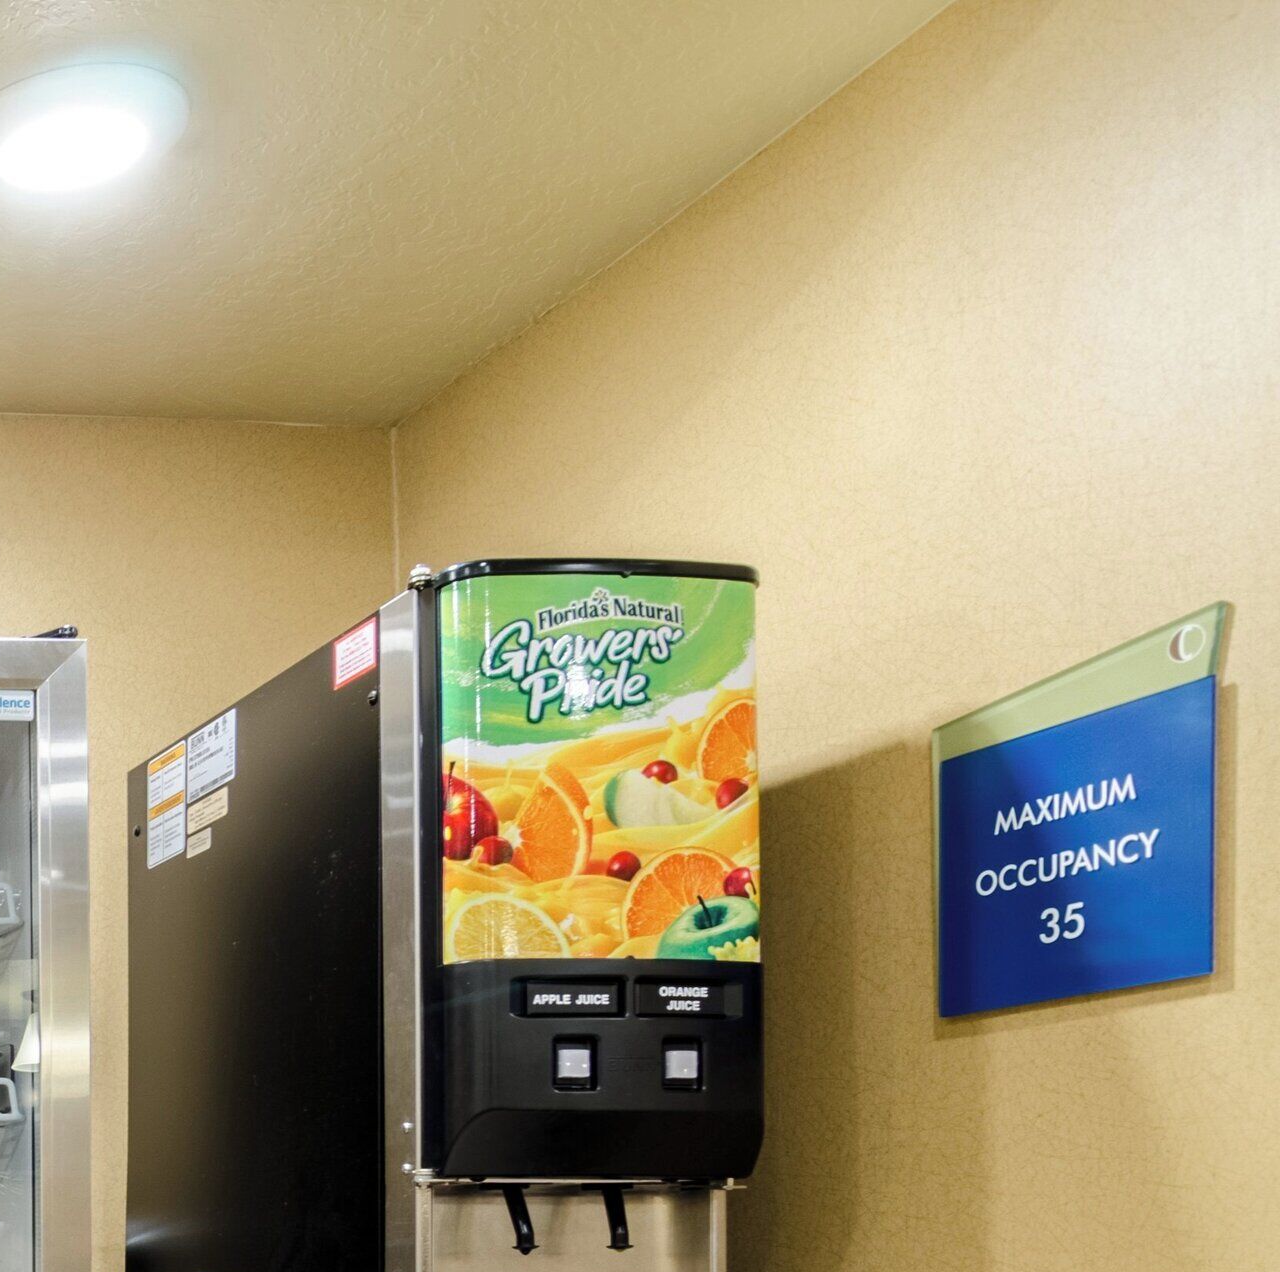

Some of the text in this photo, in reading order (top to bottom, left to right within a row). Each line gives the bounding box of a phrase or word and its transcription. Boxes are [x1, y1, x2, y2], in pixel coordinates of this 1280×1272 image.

[993, 773, 1137, 836] MAXIMUM
[975, 828, 1160, 897] OCCUPANCY
[1039, 901, 1086, 944] 35
[532, 994, 610, 1005] APPLE JUICE
[658, 986, 709, 998] ORANGE
[666, 1000, 701, 1011] JUICE
